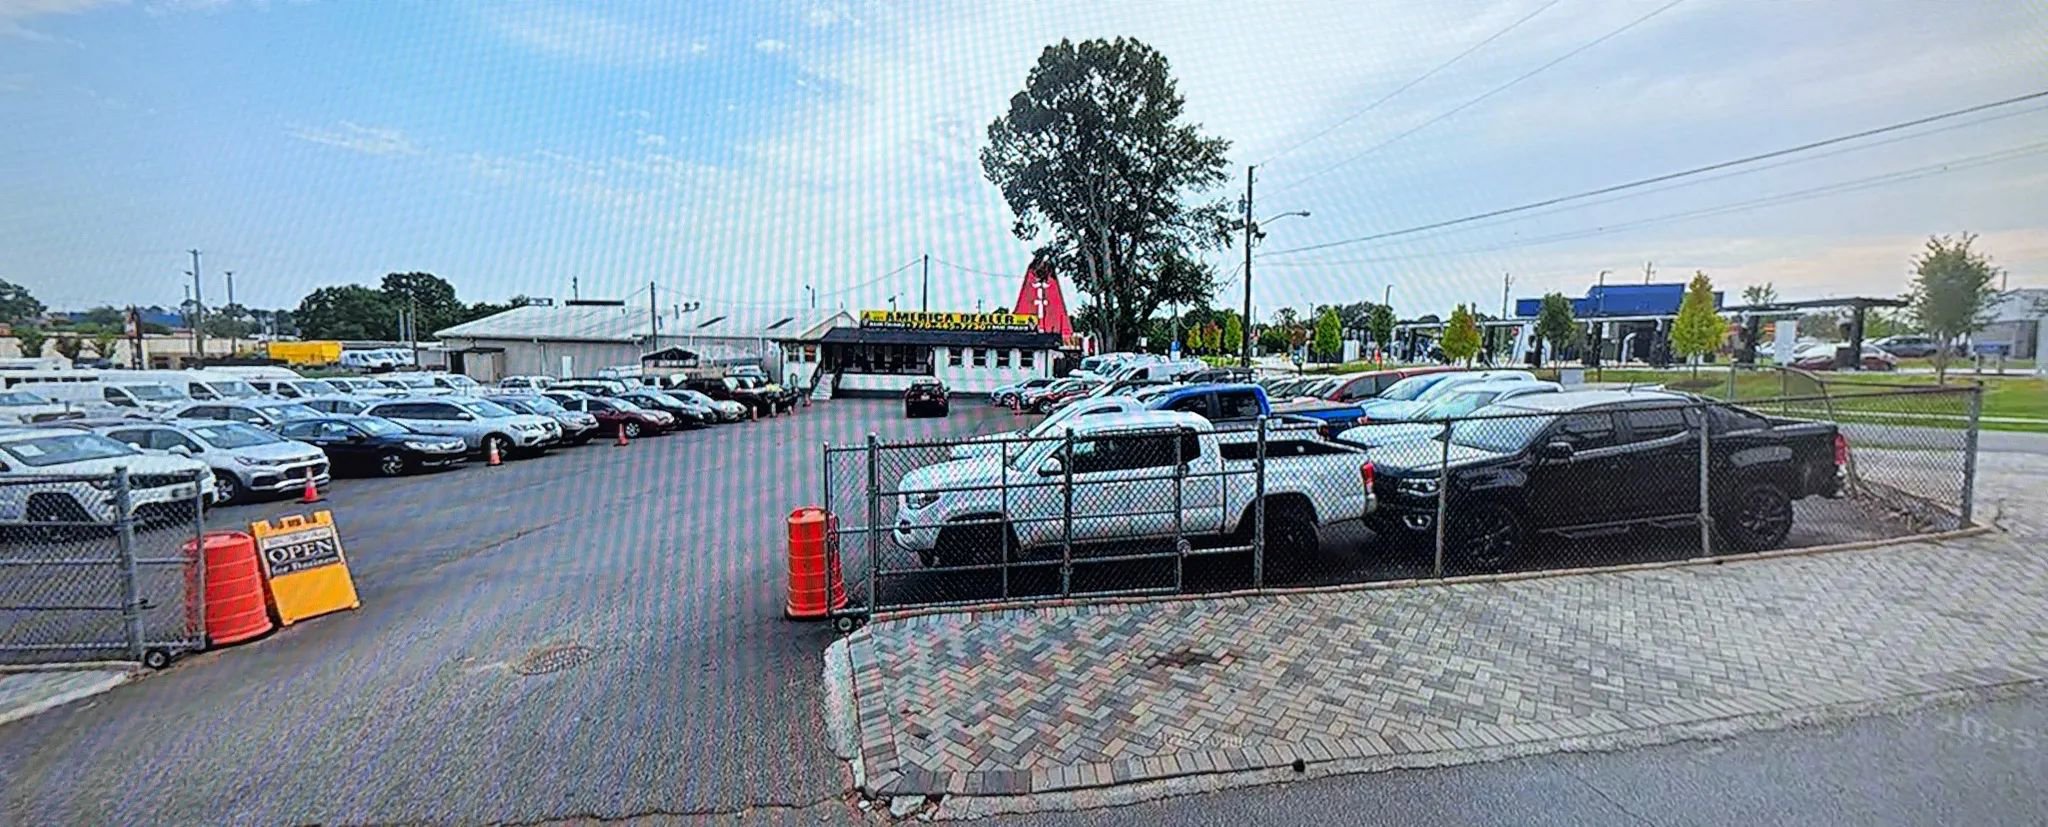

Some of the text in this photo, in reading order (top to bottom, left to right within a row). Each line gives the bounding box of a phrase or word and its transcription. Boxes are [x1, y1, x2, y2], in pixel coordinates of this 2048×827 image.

[885, 311, 954, 323] AMERICA
[960, 313, 1015, 324] DEALER
[269, 539, 333, 562] OPEN
